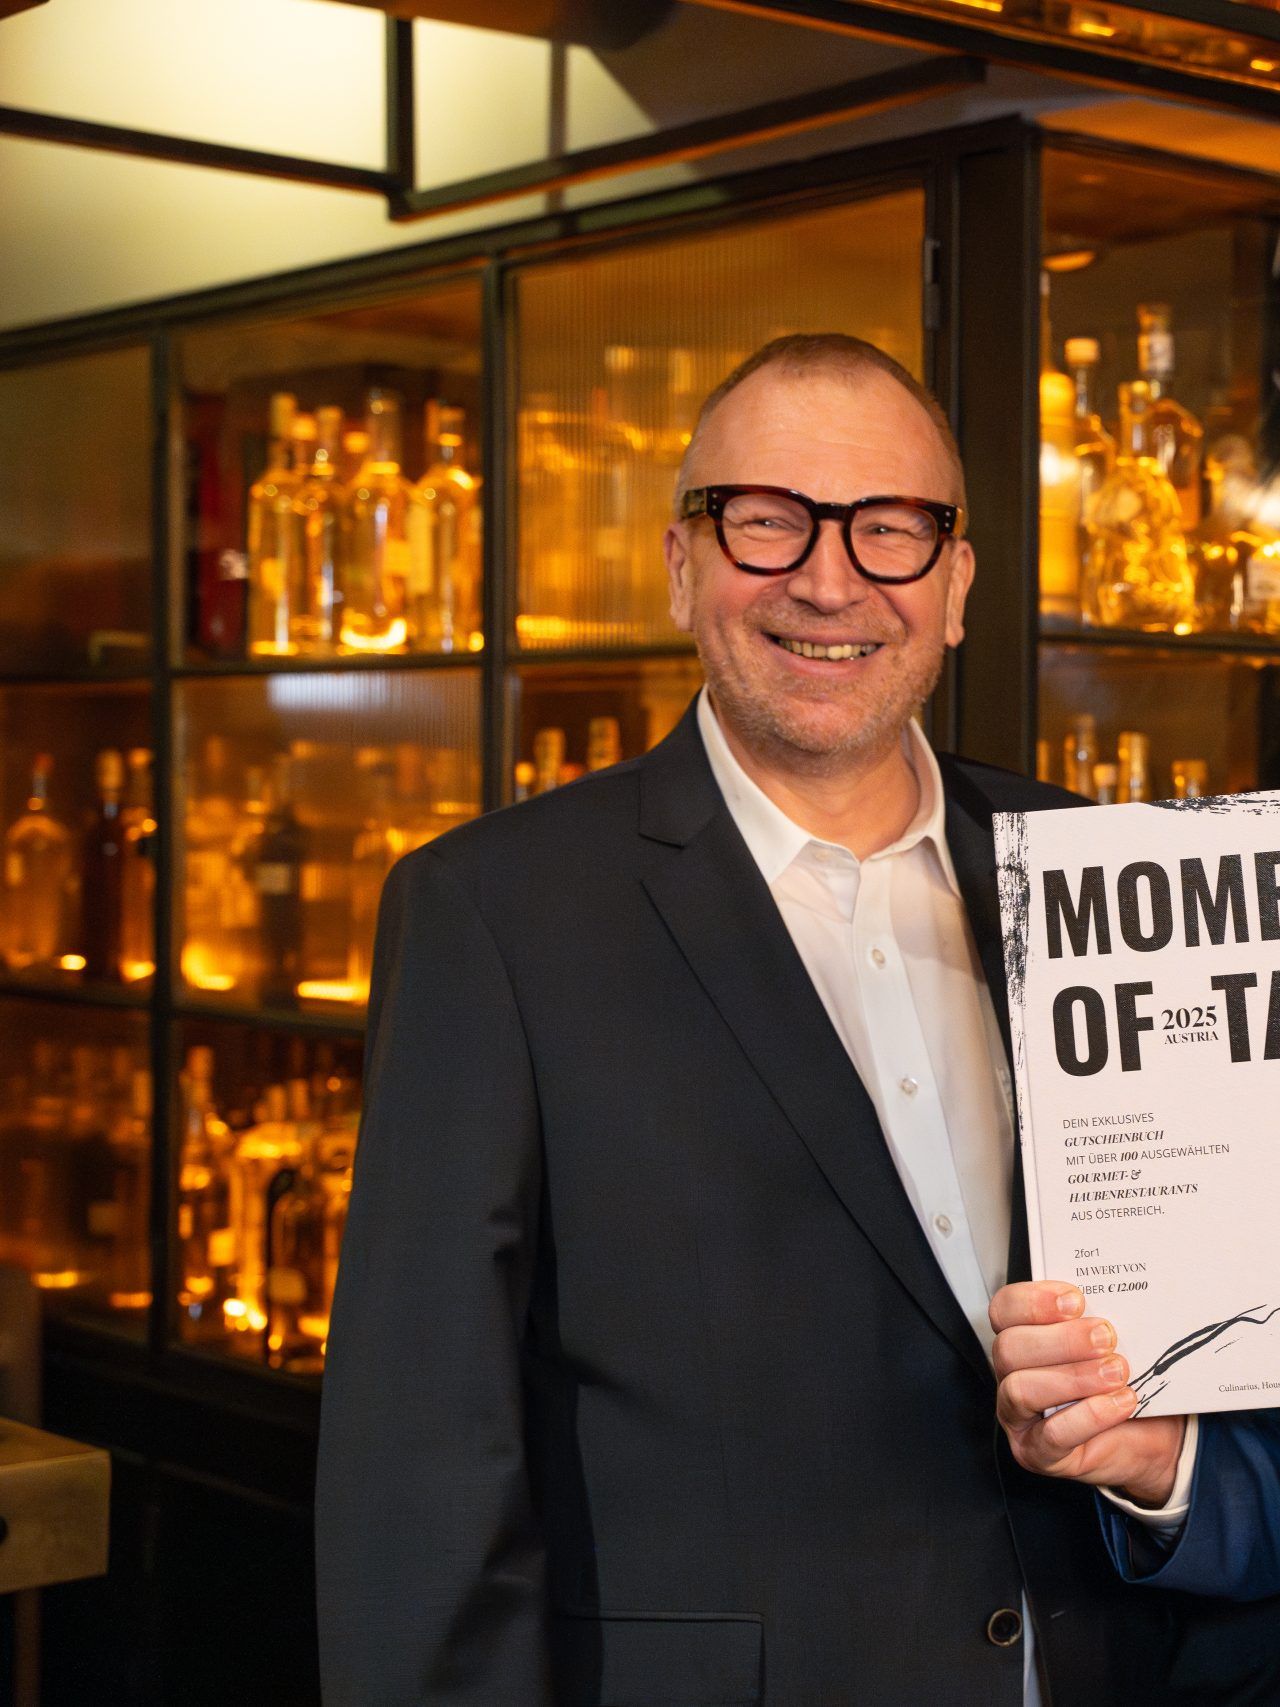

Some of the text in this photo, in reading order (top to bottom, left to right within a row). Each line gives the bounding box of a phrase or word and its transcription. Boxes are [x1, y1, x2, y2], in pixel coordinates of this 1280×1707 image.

[1161, 1005, 1217, 1030] 2025
[1052, 980, 1154, 1077] OF
[1164, 1031, 1219, 1045] AUSTRIA
[1062, 1112, 1155, 1129] DEIN EXKLUSIVES
[1064, 1130, 1165, 1147] GUTSCHEINBUCH
[1066, 1143, 1230, 1166] MIT ÜBER 100 AUSGEWÄHLTEN
[1067, 1169, 1142, 1184] GOURMET- &
[1069, 1183, 1199, 1203] HAUBENRESTAURANTS
[1070, 1205, 1166, 1222] AUS ÖSTERREICH.
[1074, 1247, 1100, 1259] 2for1
[1076, 1262, 1147, 1277] IM WERT VON
[1117, 1281, 1148, 1293] 12.000
[1218, 1383, 1260, 1393] Culinarius,
